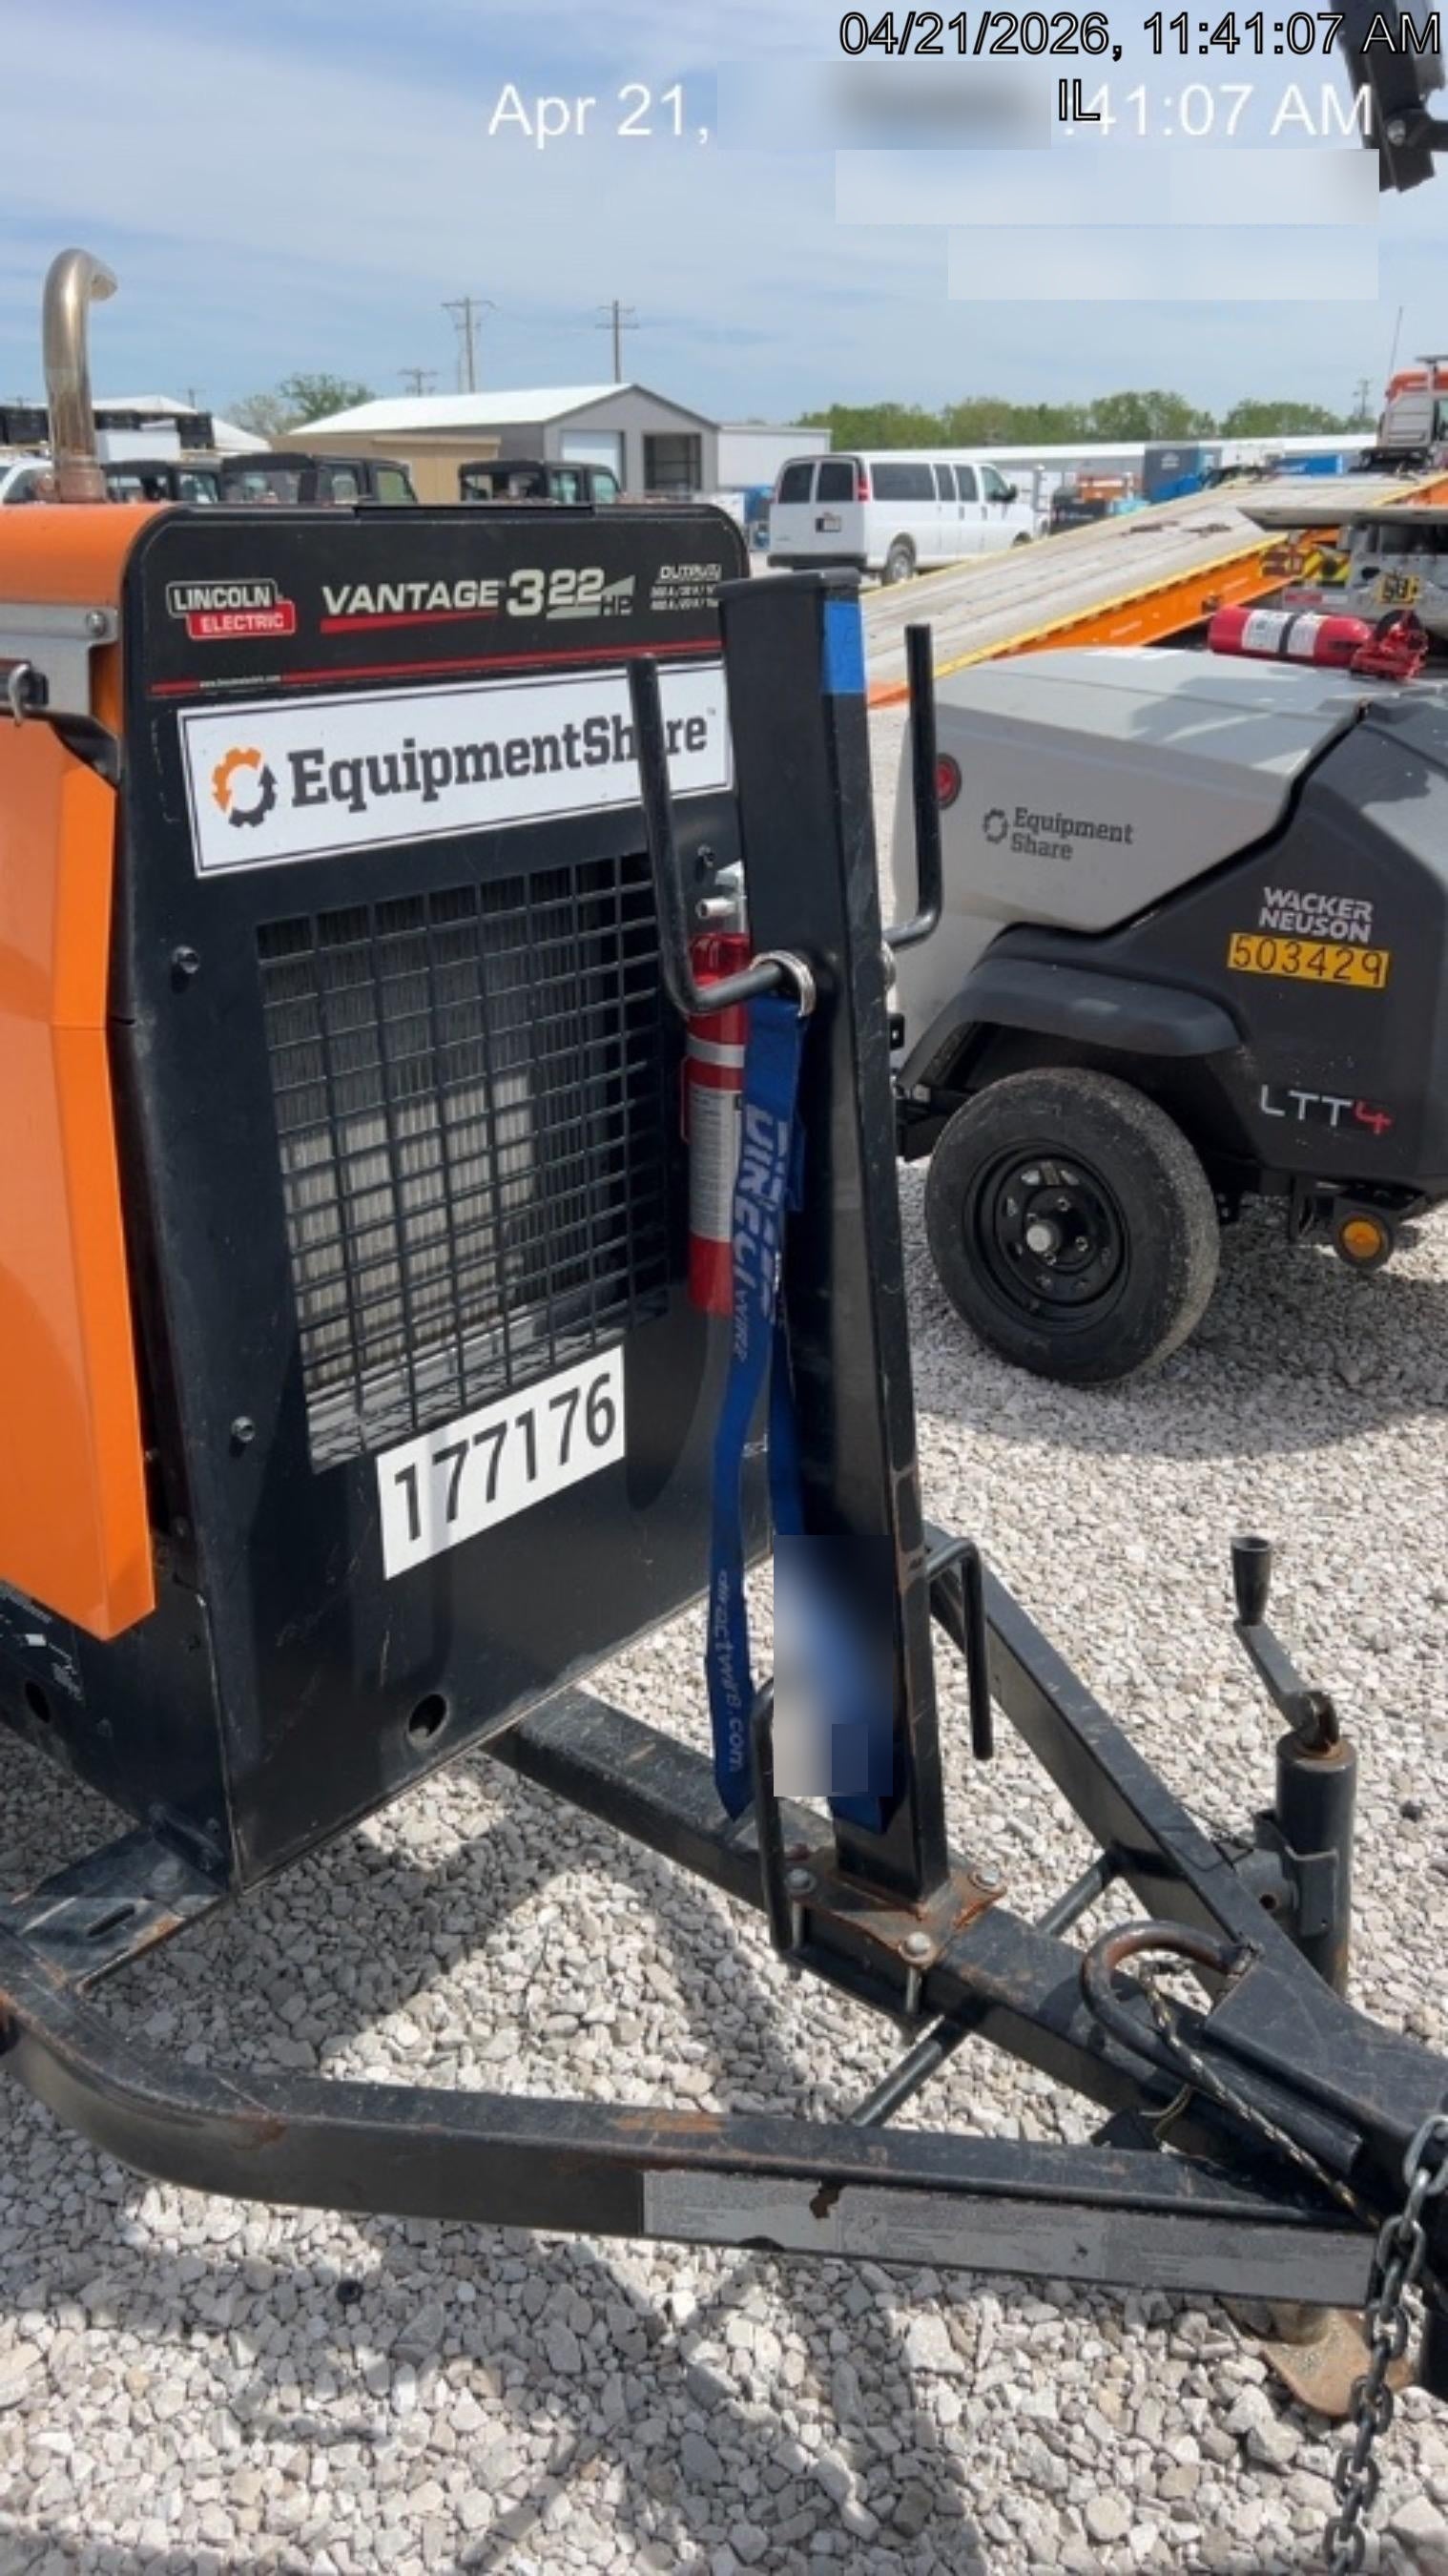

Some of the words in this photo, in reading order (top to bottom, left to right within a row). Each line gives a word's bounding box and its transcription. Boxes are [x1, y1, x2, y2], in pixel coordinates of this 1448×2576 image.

[173, 586, 271, 611] LINCOLN
[321, 580, 499, 615] VANTAGE
[200, 613, 285, 634] ELECTRIC
[288, 715, 707, 812] EquipmentShre
[1013, 806, 1133, 845] Equipment
[1010, 832, 1073, 861] Share
[1263, 886, 1375, 923] WACKER
[1259, 907, 1373, 944] NEUSON
[1233, 936, 1383, 986] 503429
[1261, 1084, 1393, 1134] LTT4
[394, 1372, 616, 1543] 177176
